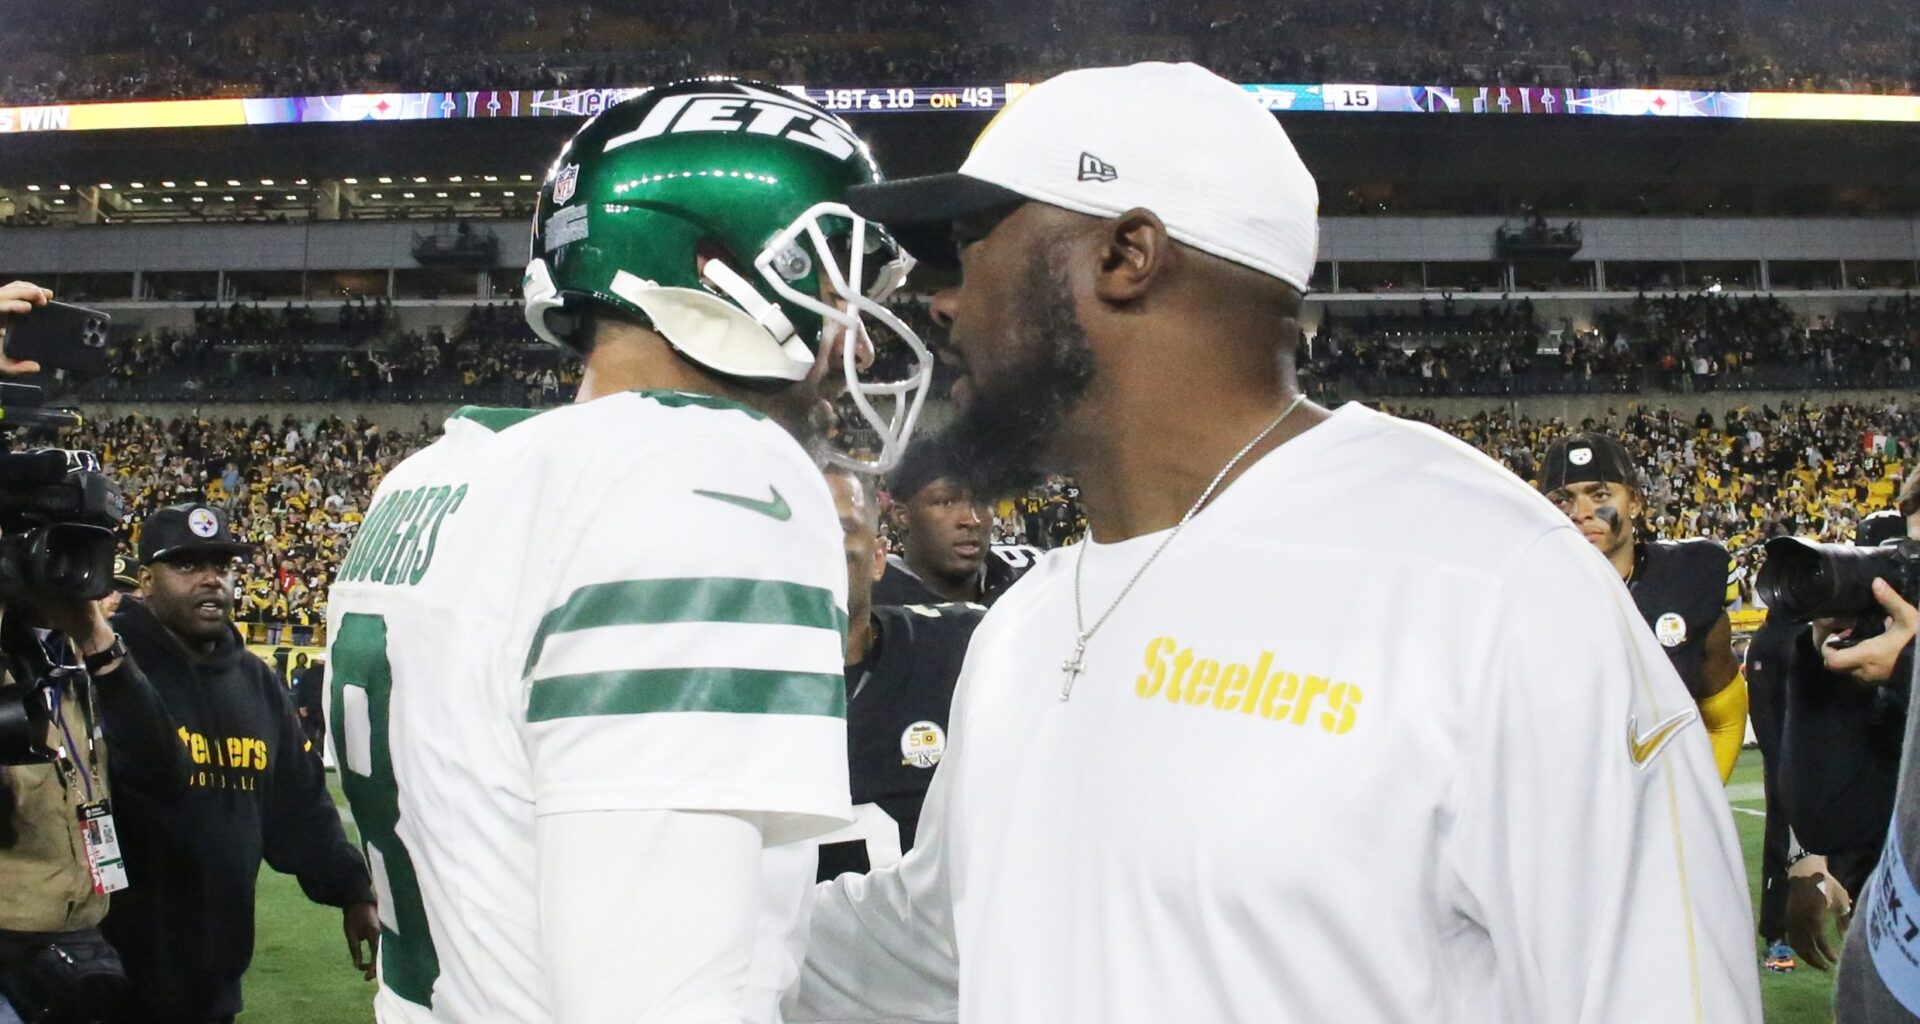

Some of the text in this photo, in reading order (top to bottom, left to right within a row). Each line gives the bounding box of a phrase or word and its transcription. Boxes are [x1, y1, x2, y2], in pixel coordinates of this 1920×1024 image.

[19, 106, 70, 131] WIN
[603, 83, 855, 161] JETS
[825, 88, 993, 110] 1ST & 10 ON 43
[1342, 90, 1370, 107] 15
[1135, 635, 1363, 736] Steelers
[331, 612, 440, 1010] 8
